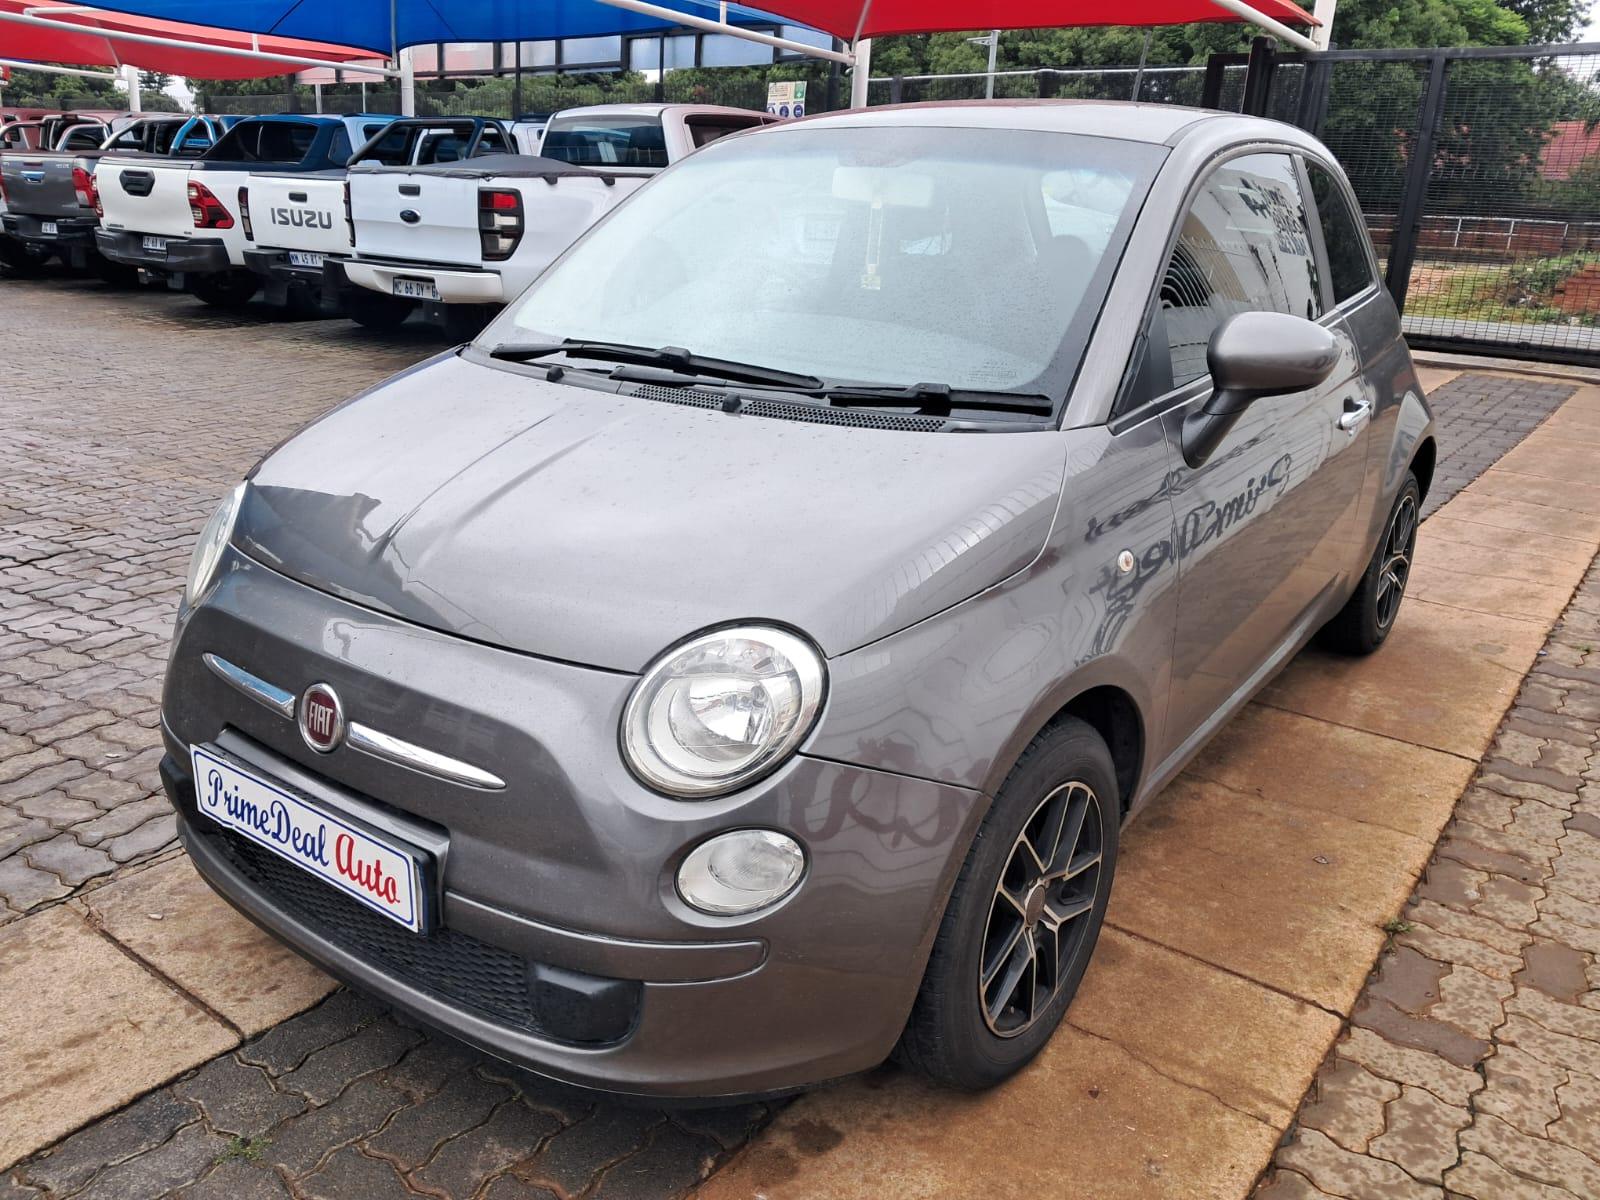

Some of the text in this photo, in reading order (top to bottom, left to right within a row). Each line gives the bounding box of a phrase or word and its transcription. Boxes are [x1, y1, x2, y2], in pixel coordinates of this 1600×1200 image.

[270, 207, 332, 230] ISUZU
[404, 281, 413, 295] 66
[416, 282, 425, 297] DY
[308, 700, 334, 736] FIAT
[208, 769, 401, 905] PrimeDeal Auto
